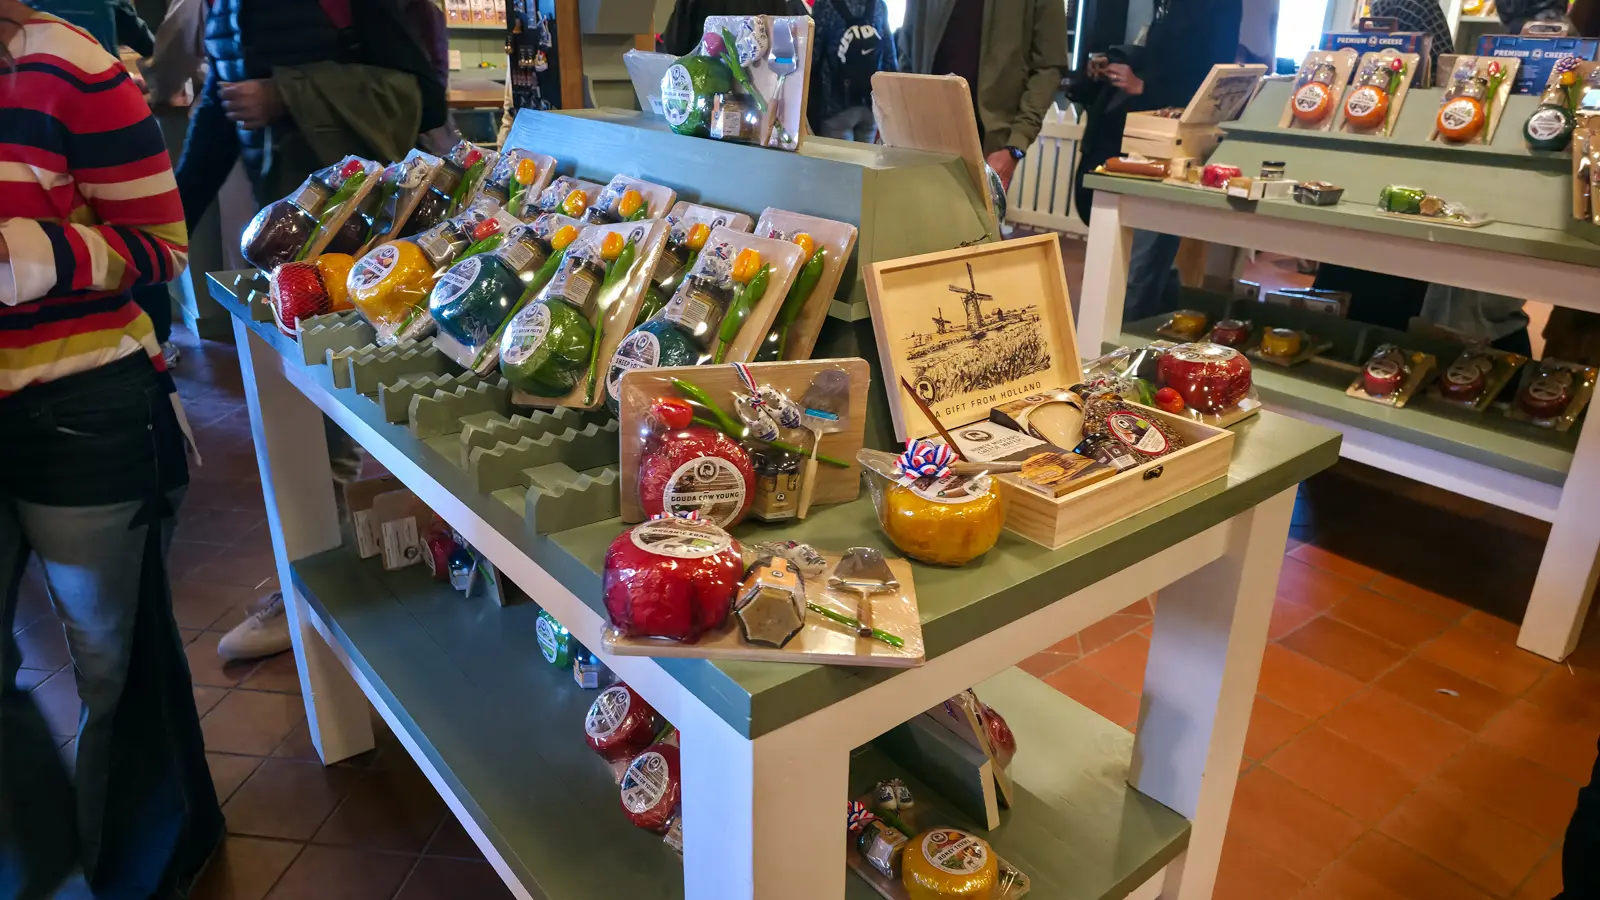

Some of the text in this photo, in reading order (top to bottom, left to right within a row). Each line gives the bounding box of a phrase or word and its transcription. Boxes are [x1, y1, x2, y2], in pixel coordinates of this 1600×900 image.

[837, 25, 860, 64] JUST
[1336, 37, 1367, 45] PREMIUM
[1493, 49, 1529, 57] PREMIUM
[934, 381, 1041, 418] A GIFT FROM HOLLAND
[698, 493, 715, 501] COW
[715, 491, 740, 499] YOUNG
[937, 847, 955, 861] HONEY
